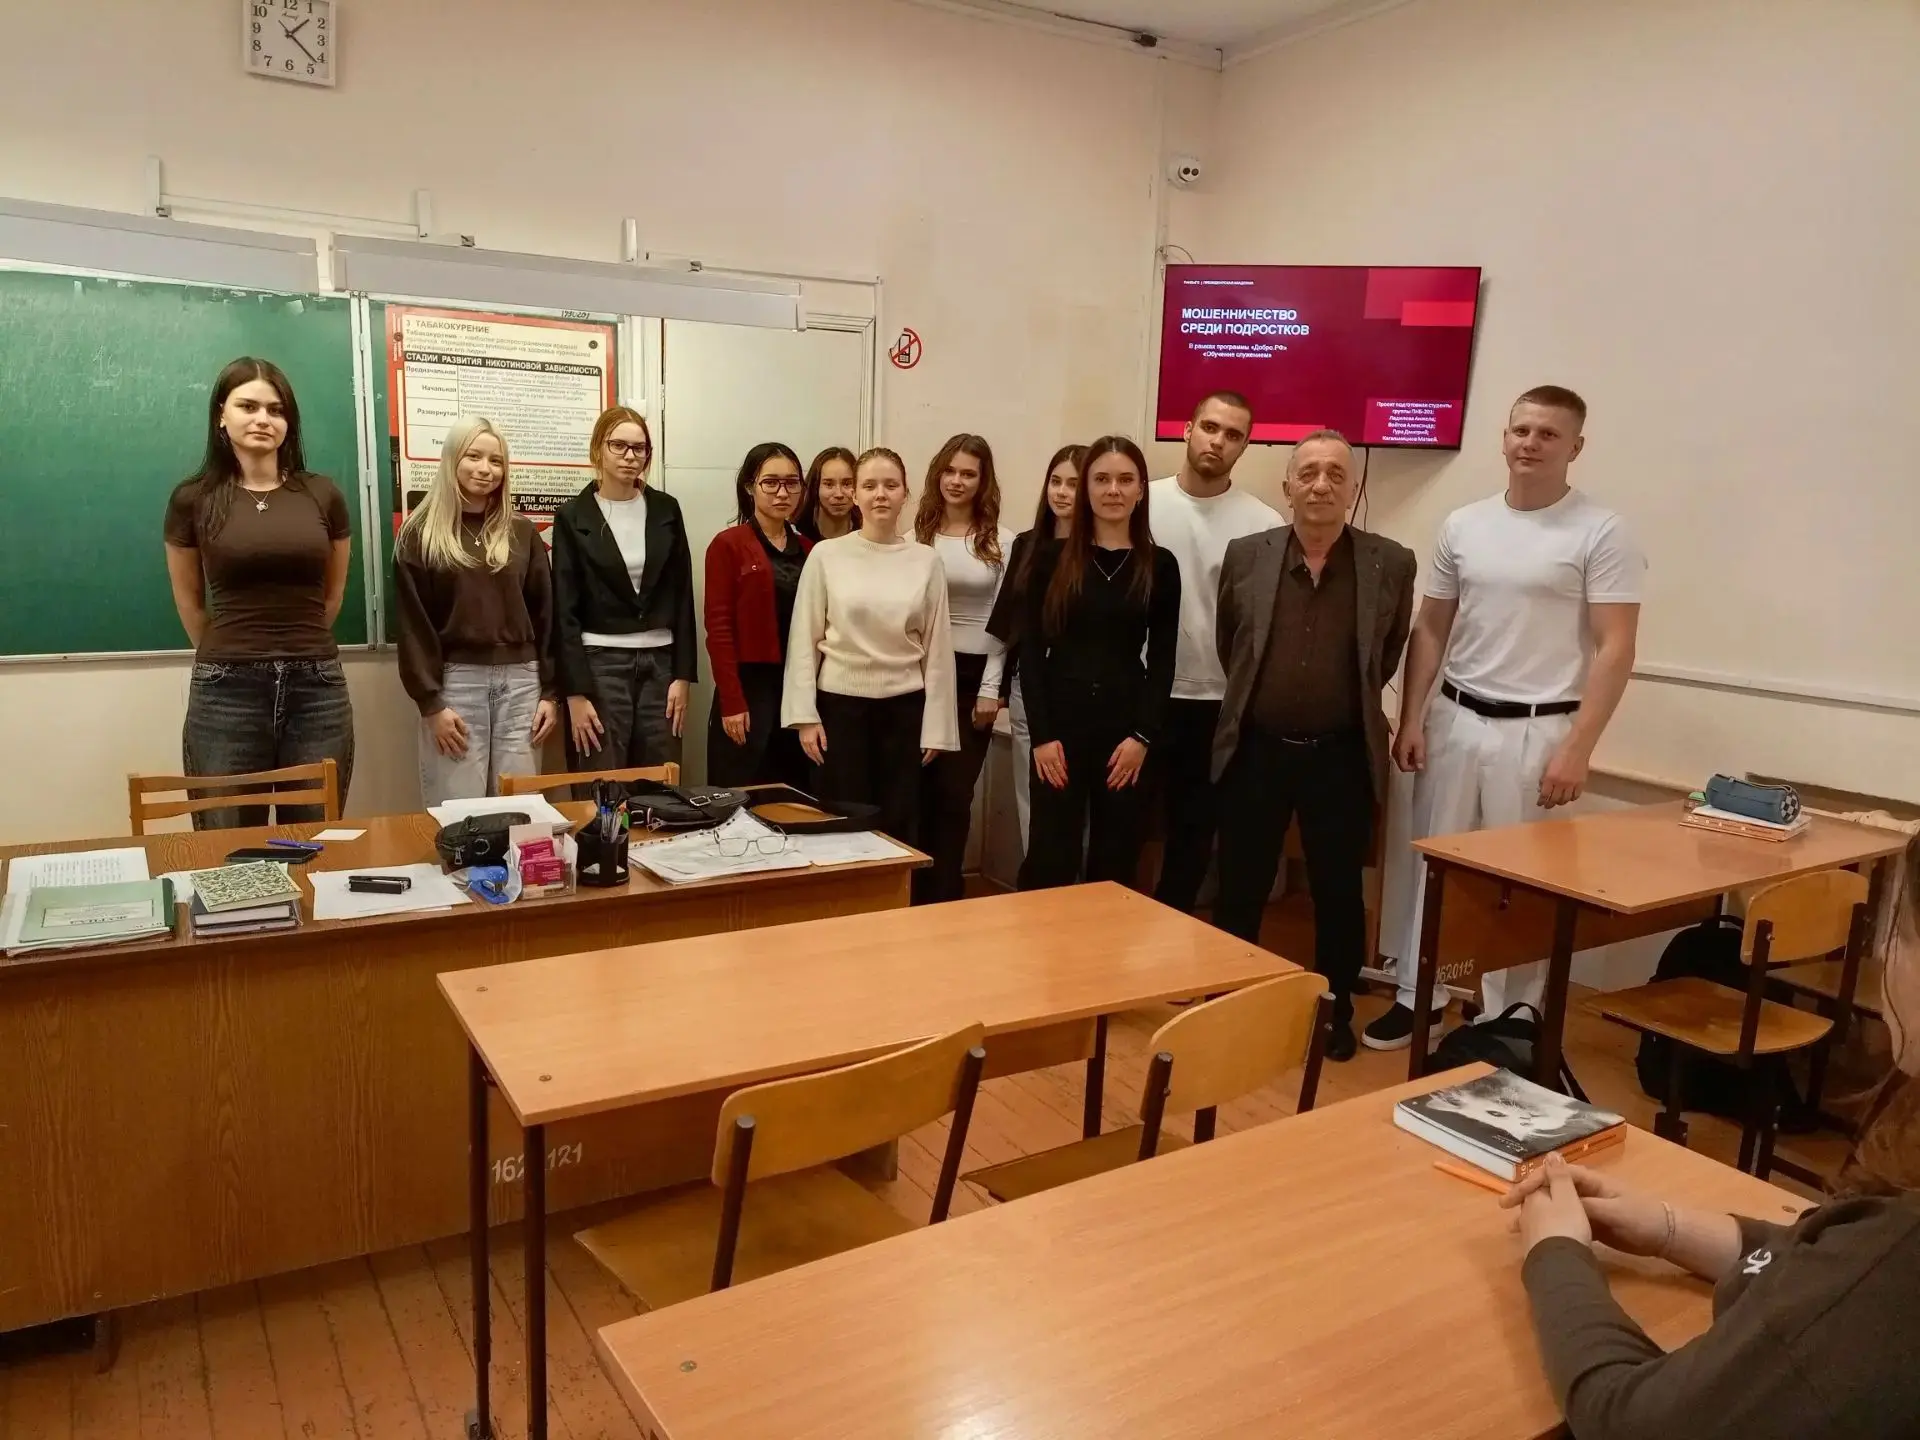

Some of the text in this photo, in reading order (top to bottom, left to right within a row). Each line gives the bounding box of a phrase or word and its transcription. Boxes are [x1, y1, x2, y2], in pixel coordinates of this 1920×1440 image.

[252, 5, 268, 18] 10
[306, 2, 313, 14] 1
[252, 22, 262, 34] 9
[317, 17, 326, 30] 2
[252, 39, 262, 52] 8
[317, 34, 326, 47] 3
[263, 54, 273, 67] 7
[316, 52, 326, 64] 4
[285, 59, 294, 71] 6
[306, 63, 315, 75] 5
[1181, 308, 1298, 321] МОШЕННИЧЕСТВО
[415, 319, 490, 334] ТАБАКОКУРЕНИЕ
[1180, 323, 1310, 337] СРЕДИ ПОДРОСТКОВ
[1194, 343, 1216, 351] рамках
[1216, 343, 1250, 352] программы
[1251, 344, 1288, 352] «Добро.РФ»
[1202, 351, 1235, 359] «Обучение
[406, 352, 599, 375] СТАДИИ РАЗВИТИЯ НИКОТИНОВОЙ ЗАВИСИМОСТИ
[421, 384, 457, 393] Начальная
[519, 495, 536, 504] ДЛЯ
[523, 503, 561, 512] ТАБАЧНО
[1435, 958, 1475, 985] 1620115
